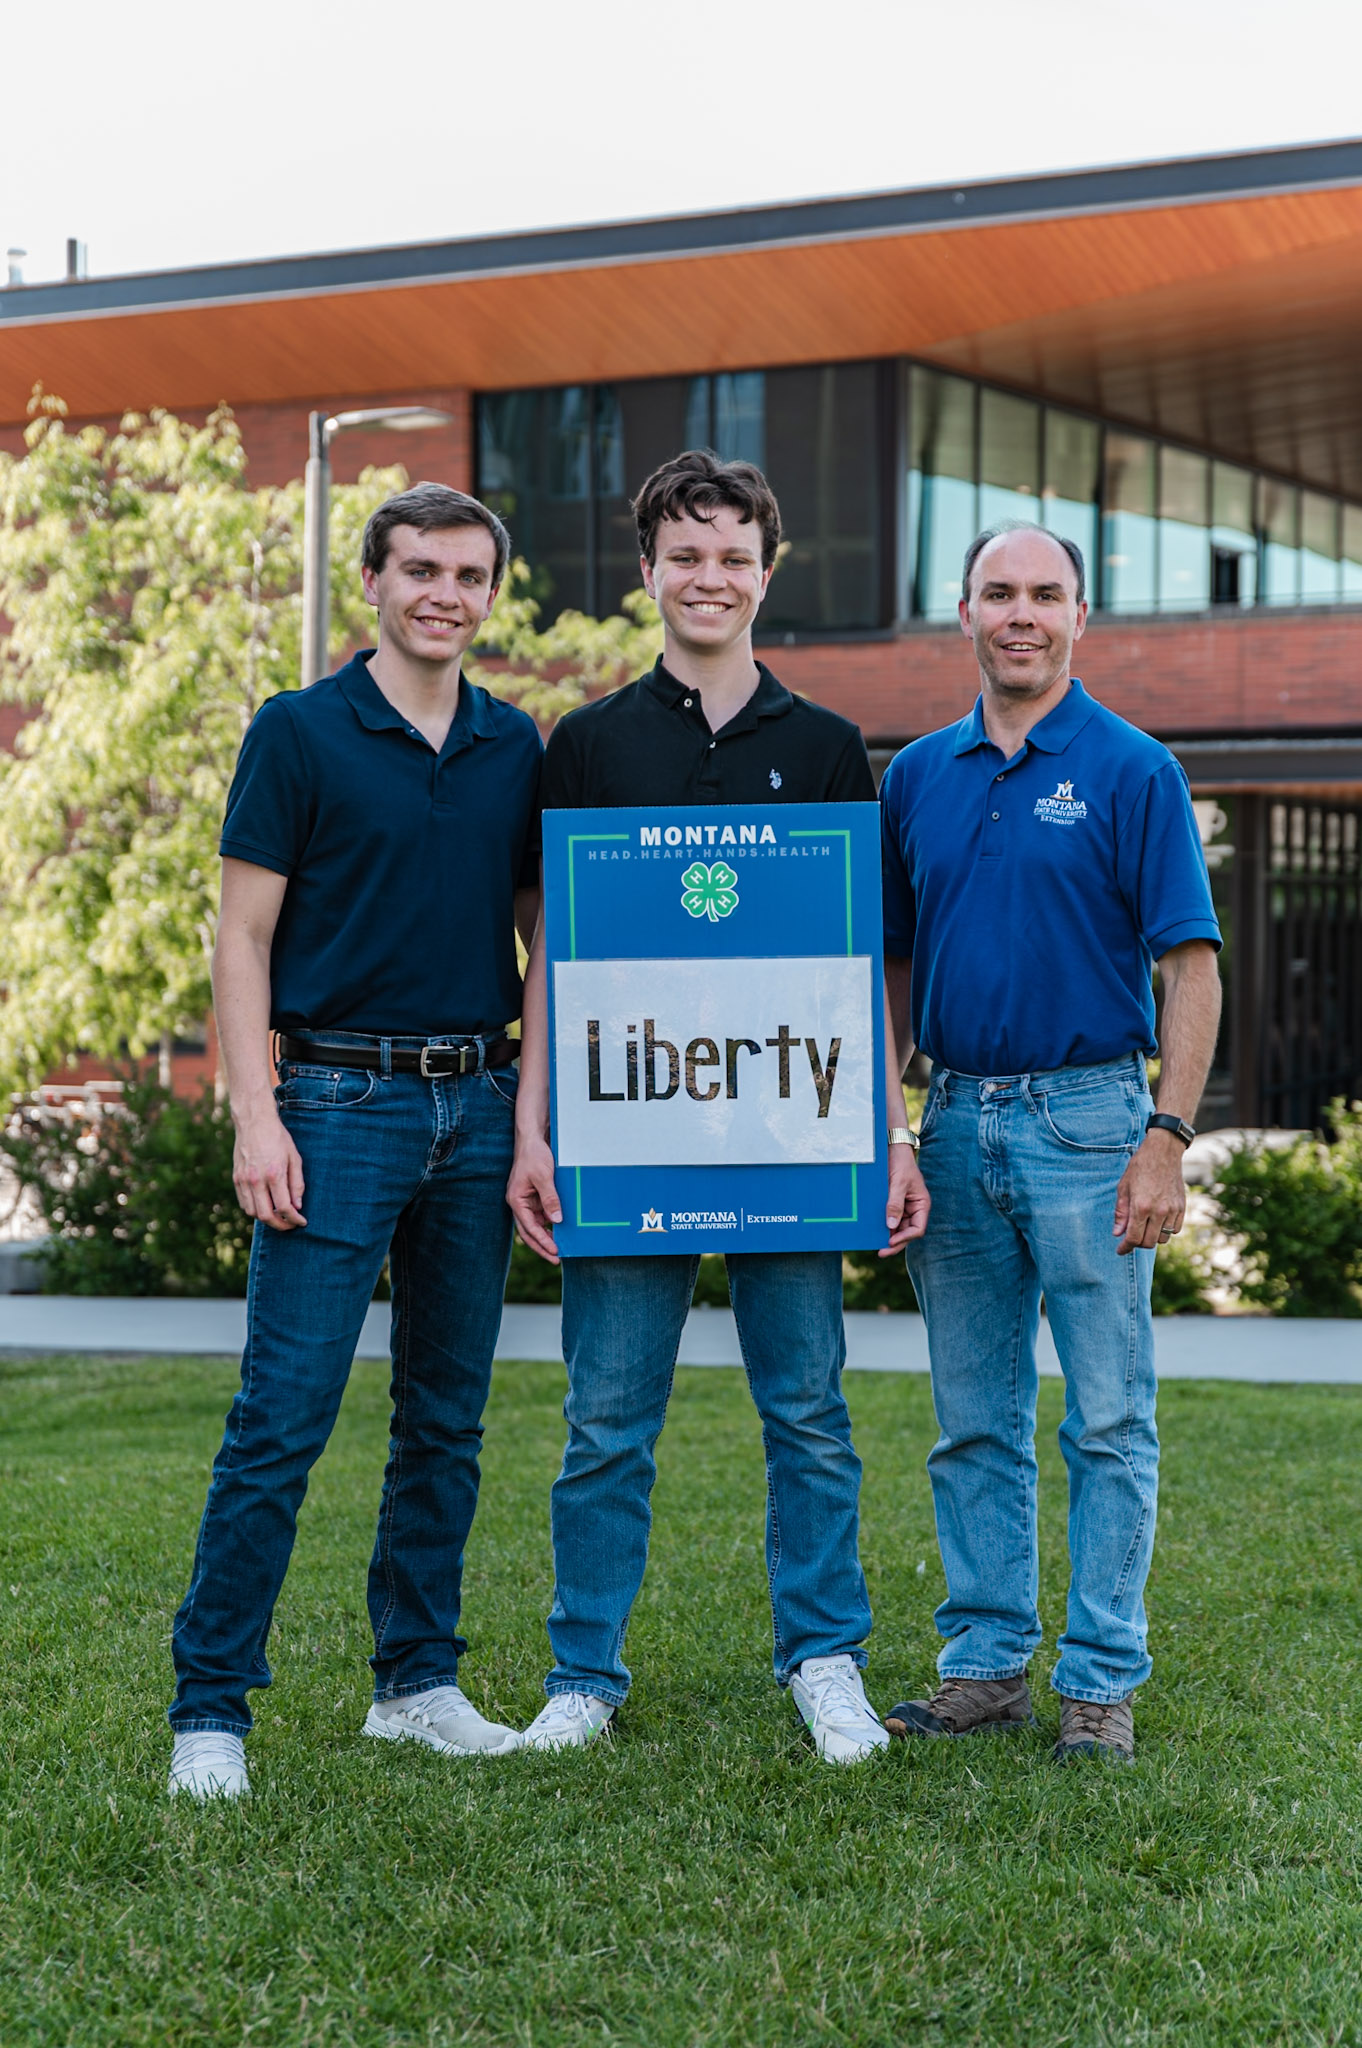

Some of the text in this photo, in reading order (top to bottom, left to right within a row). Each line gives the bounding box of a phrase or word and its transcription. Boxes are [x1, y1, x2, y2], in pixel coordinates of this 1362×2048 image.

[1036, 798, 1087, 810] MONTANA
[1051, 808, 1087, 816] UNIVERSITY
[640, 825, 777, 846] MONTANA
[587, 1019, 842, 1118] Liberty
[671, 1211, 738, 1223] MONTANA
[695, 1222, 738, 1230] UNIVERSITY
